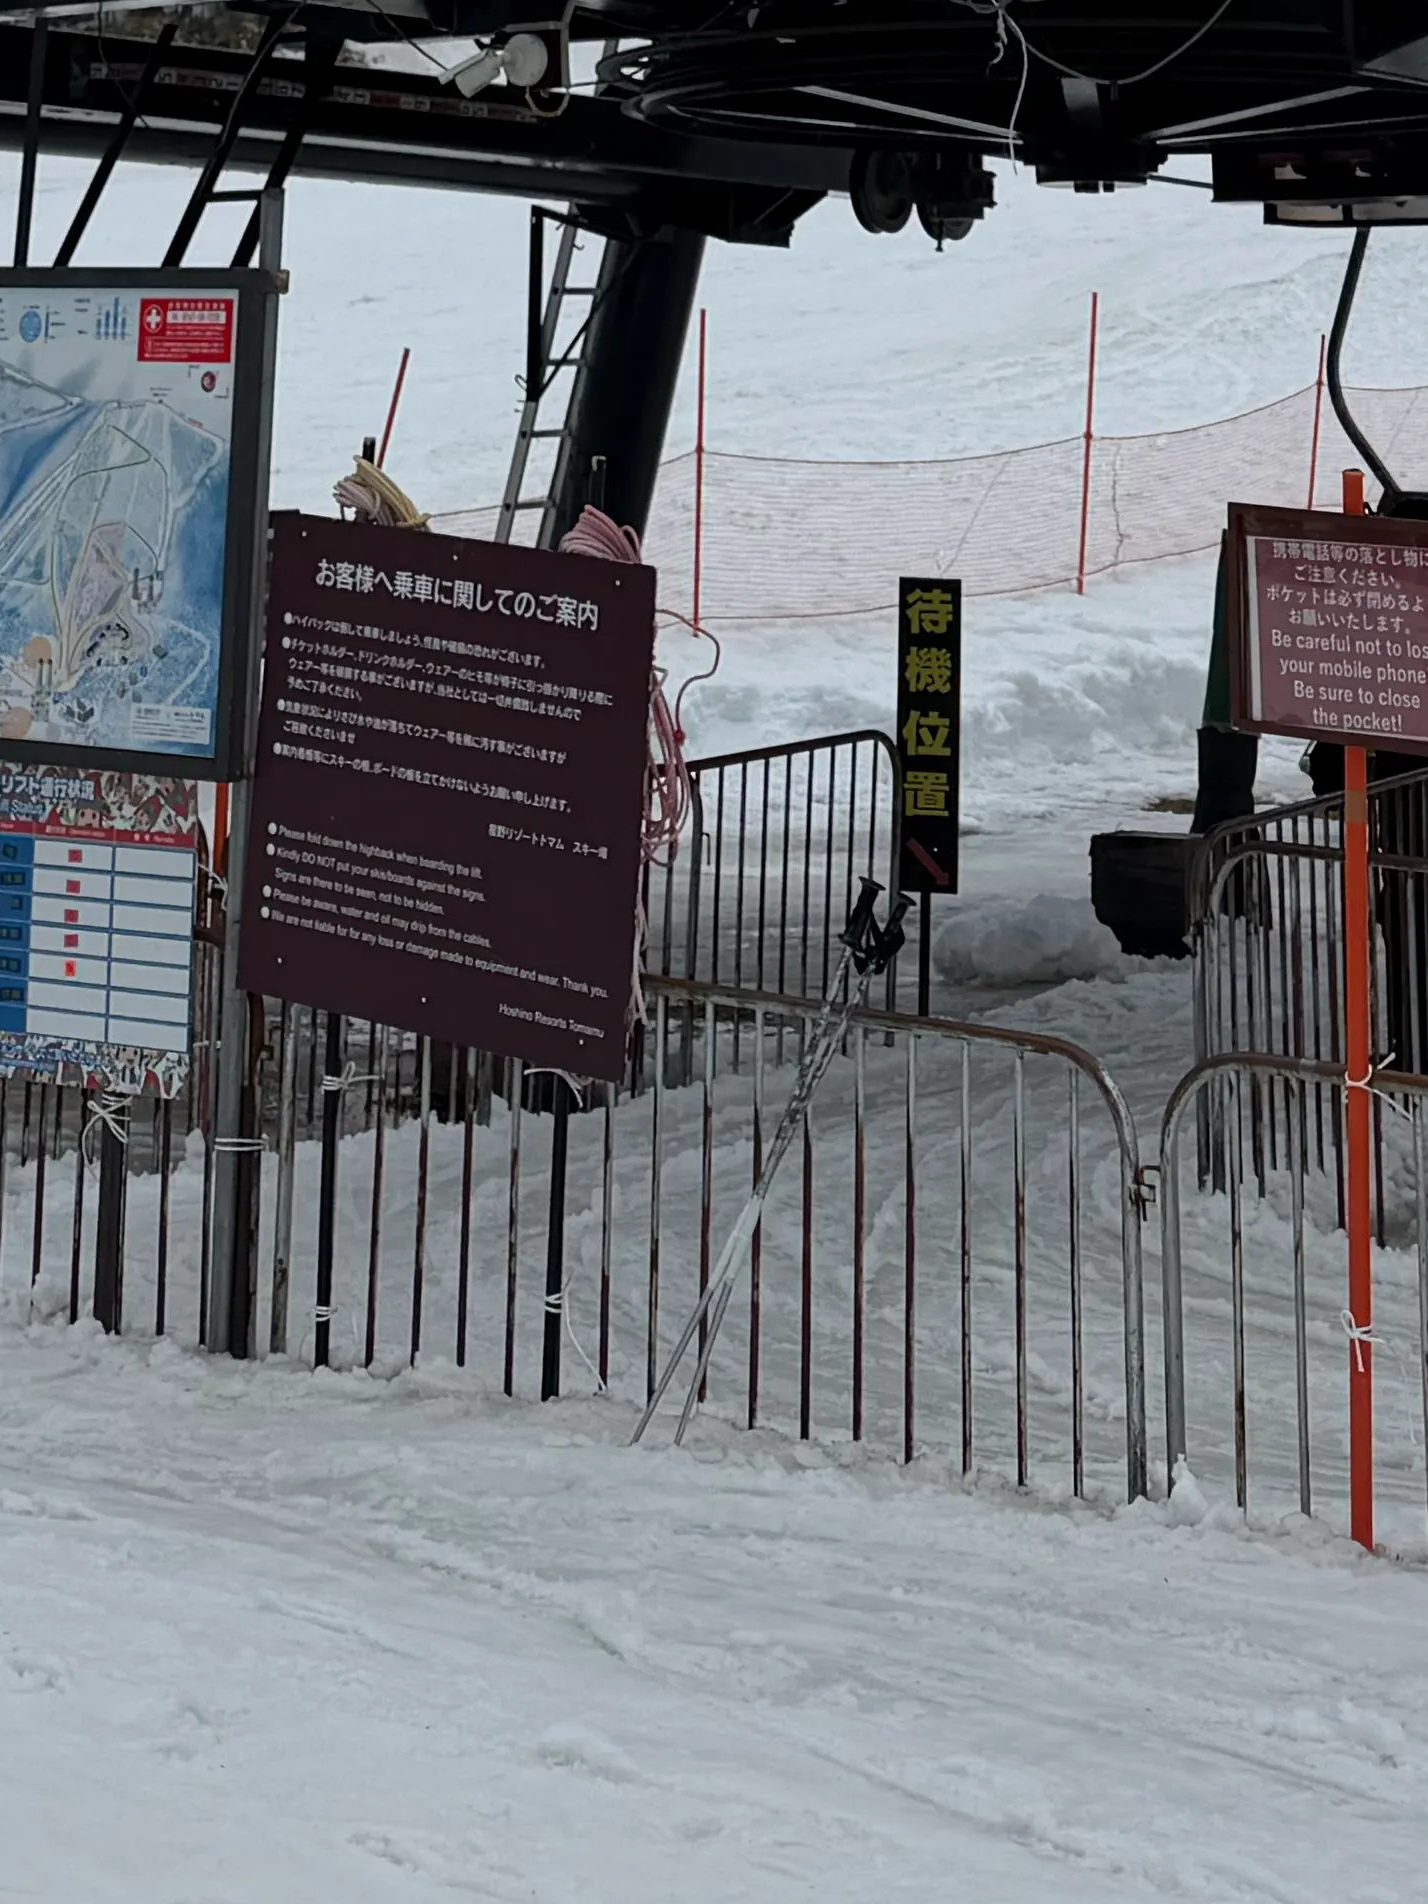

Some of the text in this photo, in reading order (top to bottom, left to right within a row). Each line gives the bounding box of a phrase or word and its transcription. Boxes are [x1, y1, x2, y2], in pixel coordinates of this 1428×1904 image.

[1295, 566, 1401, 589] ご注意ください。
[316, 558, 599, 631] お客様へ乗車に関してのご案内
[1272, 629, 1291, 647] Be
[1296, 634, 1350, 653] careful
[1356, 639, 1380, 655] not
[1386, 641, 1401, 657] to
[1280, 659, 1314, 675] your
[1319, 659, 1372, 680] mobile
[902, 587, 954, 818] 待機位置
[1294, 680, 1420, 709] Be sure to close
[1313, 707, 1402, 733] the pocket!
